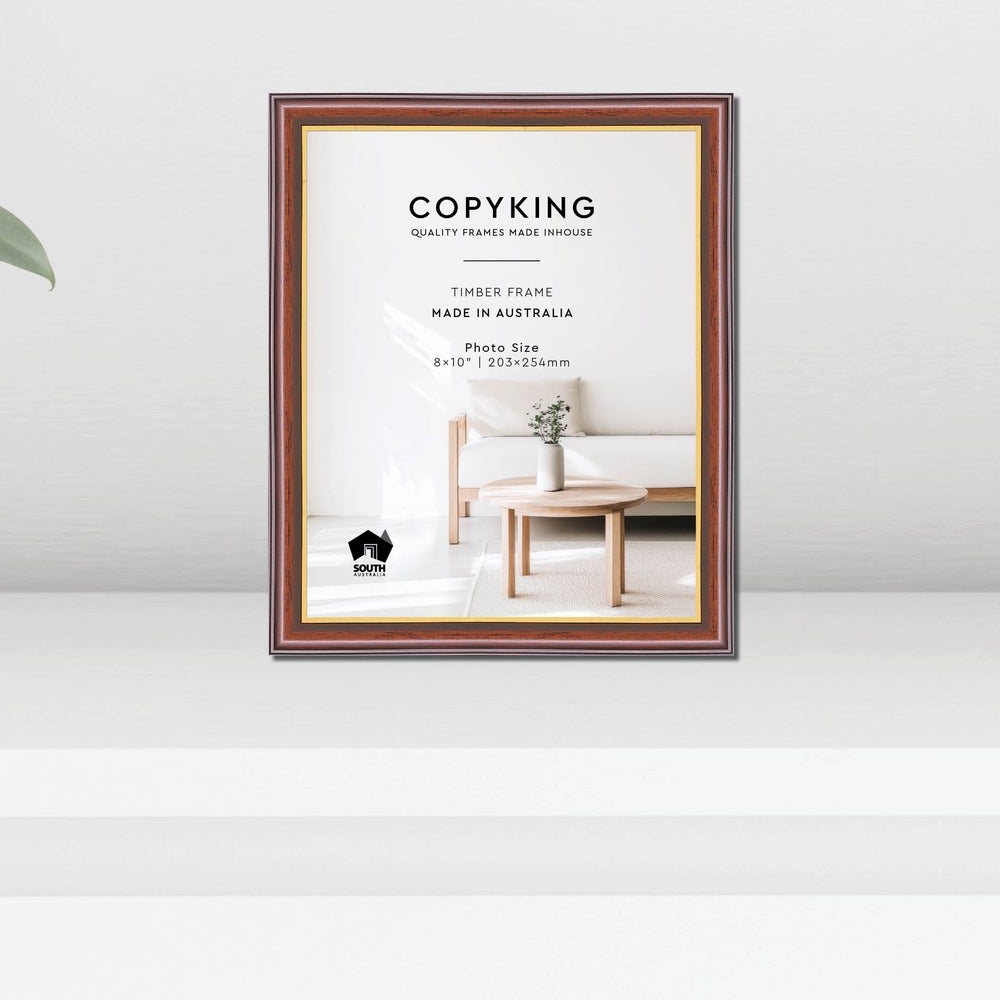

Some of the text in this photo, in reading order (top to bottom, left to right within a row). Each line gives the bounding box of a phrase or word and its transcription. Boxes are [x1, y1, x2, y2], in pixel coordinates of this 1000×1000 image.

[408, 195, 595, 220] COPYKING
[410, 228, 593, 239] QUALITY FRAMES MADE INHOUSE
[451, 286, 553, 298] TIMBER FRAME
[431, 307, 574, 318] MADE IN AUSTRALIA
[465, 341, 539, 353] Photo Size
[353, 564, 386, 573] SOUTH
